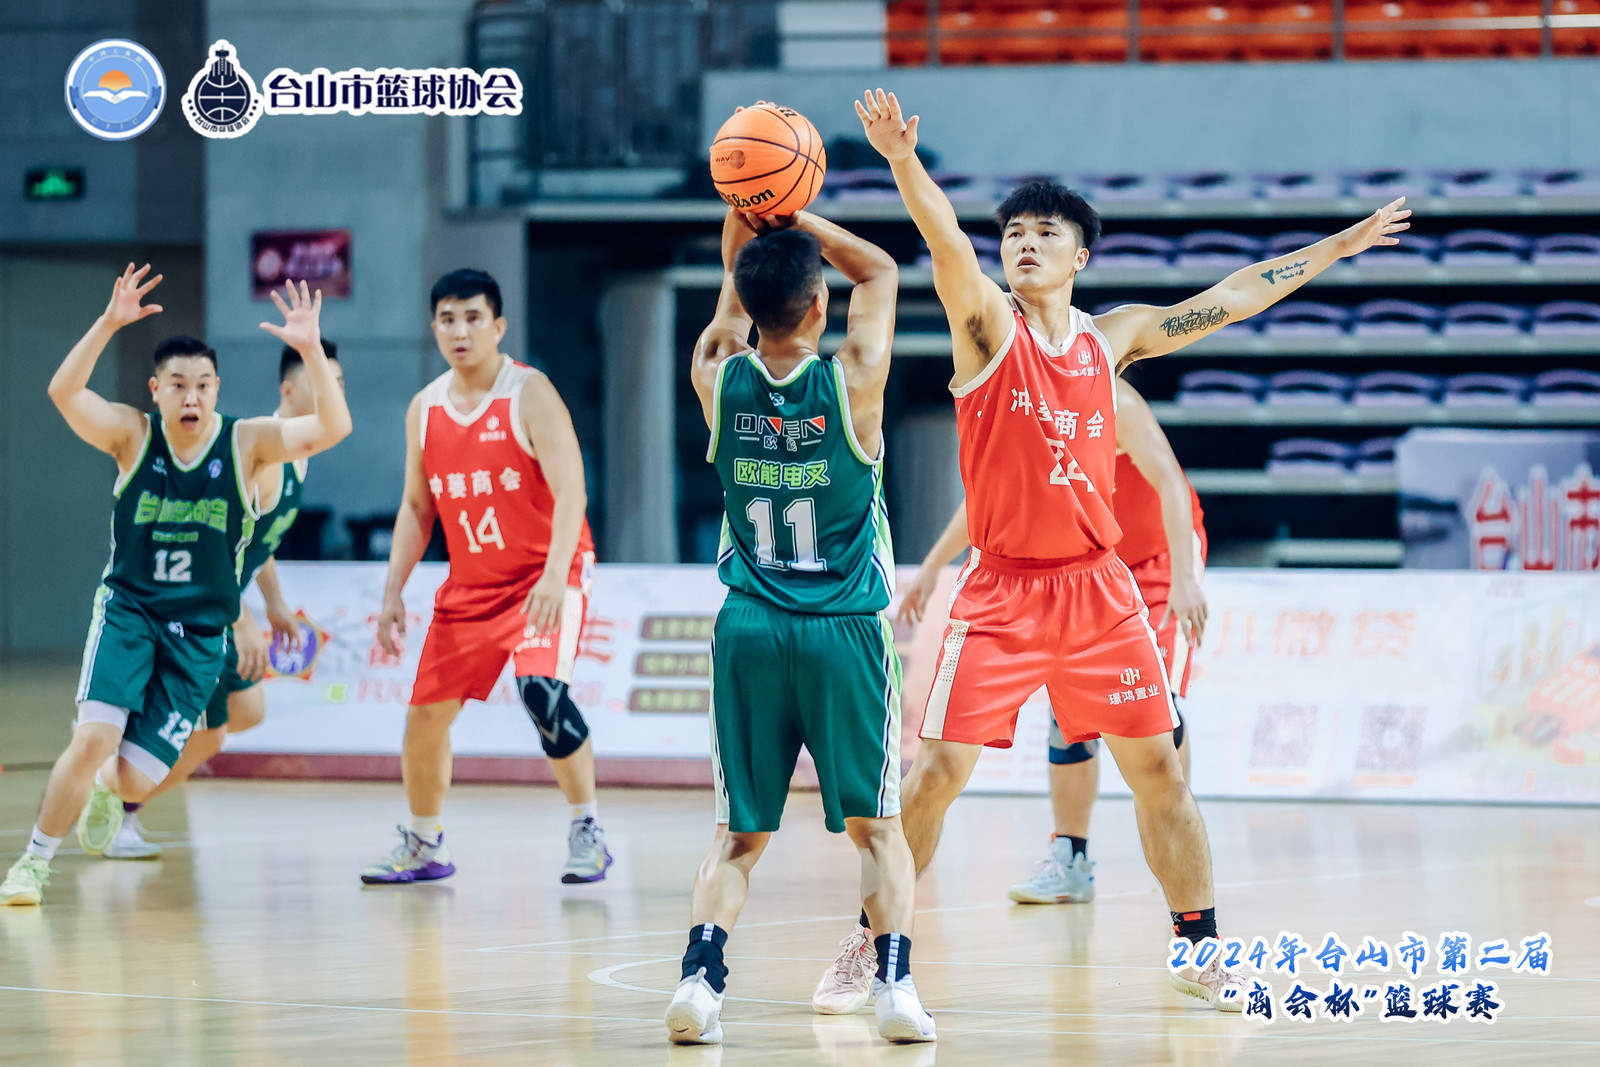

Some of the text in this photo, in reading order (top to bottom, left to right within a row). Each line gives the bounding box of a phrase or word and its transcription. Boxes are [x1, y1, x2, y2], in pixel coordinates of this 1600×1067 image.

[735, 459, 830, 489] 欧能电叉
[1049, 437, 1095, 493] 24
[459, 506, 506, 553] 14
[746, 497, 828, 572] 11
[153, 550, 193, 582] 12
[158, 711, 193, 749] 12
